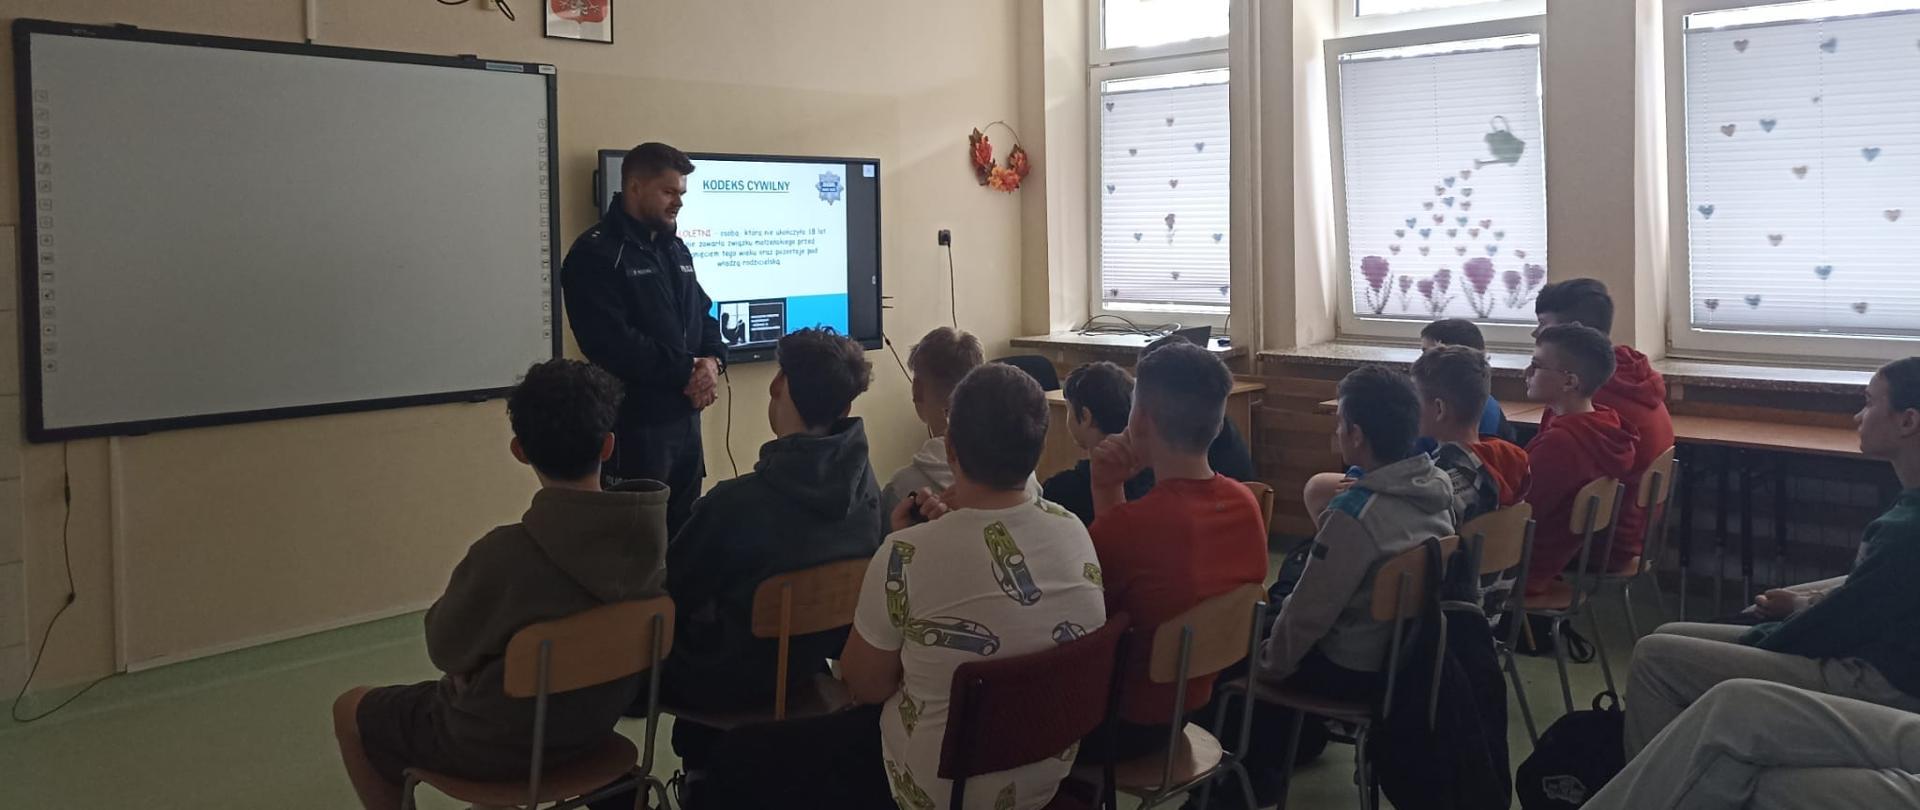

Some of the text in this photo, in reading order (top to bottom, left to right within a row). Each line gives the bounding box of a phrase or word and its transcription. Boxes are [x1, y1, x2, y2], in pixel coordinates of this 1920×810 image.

[702, 179, 790, 191] KODEKS CYWILNY
[808, 226, 816, 236] 18
[817, 227, 827, 235] lat
[797, 237, 815, 246] przed
[721, 250, 737, 259] tego
[738, 249, 757, 257] wieku
[758, 249, 774, 257] oraz
[807, 247, 818, 256] pod
